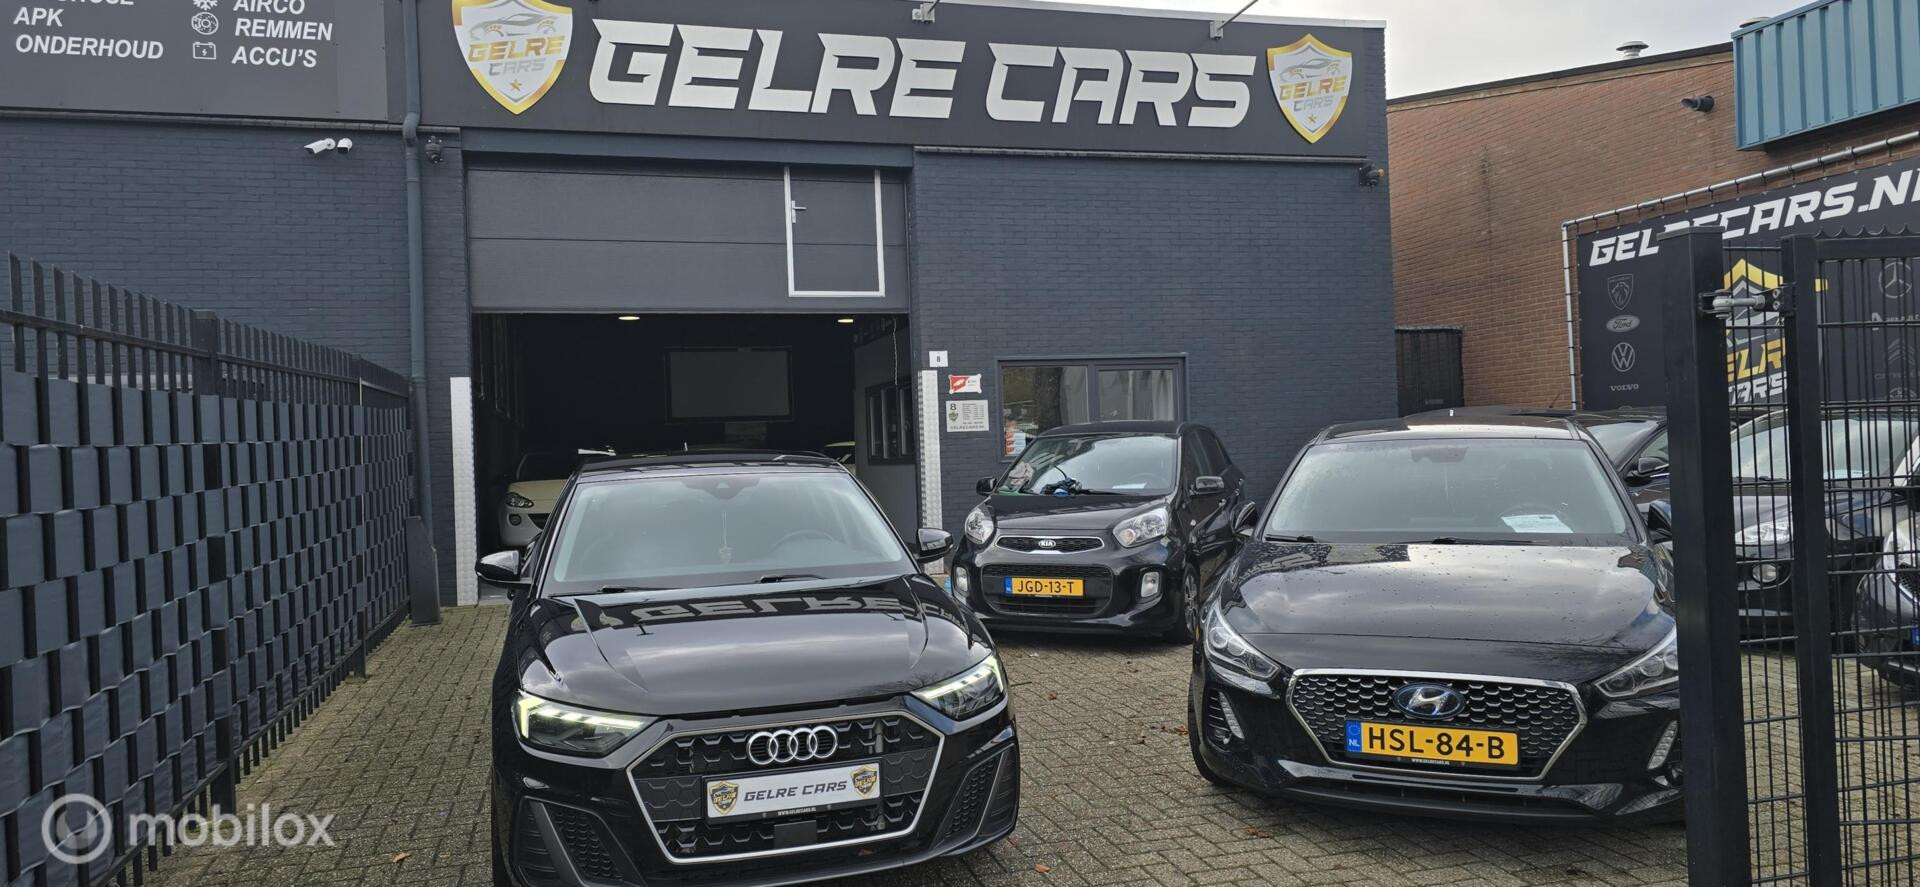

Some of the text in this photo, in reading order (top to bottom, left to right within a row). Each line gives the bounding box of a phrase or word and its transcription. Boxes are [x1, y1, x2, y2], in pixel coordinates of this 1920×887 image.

[13, 6, 64, 27] APK
[233, 0, 305, 14] AIRCO
[234, 18, 333, 41] REMMEN
[15, 34, 164, 59] ONDERHOUD
[231, 46, 317, 68] ACCU'S
[468, 35, 565, 62] GELRE
[488, 59, 544, 76] CARS
[589, 18, 1257, 128] GELRE CARS
[1279, 75, 1346, 101] GELRE
[1293, 96, 1334, 112] CARS
[936, 355, 942, 364] 8
[1609, 383, 1640, 392] VOLVO
[950, 403, 957, 411] 8
[1017, 581, 1074, 593] JGD-13-T
[1348, 726, 1505, 760] NL HSL-84-B
[743, 780, 848, 802] GELRE CARS
